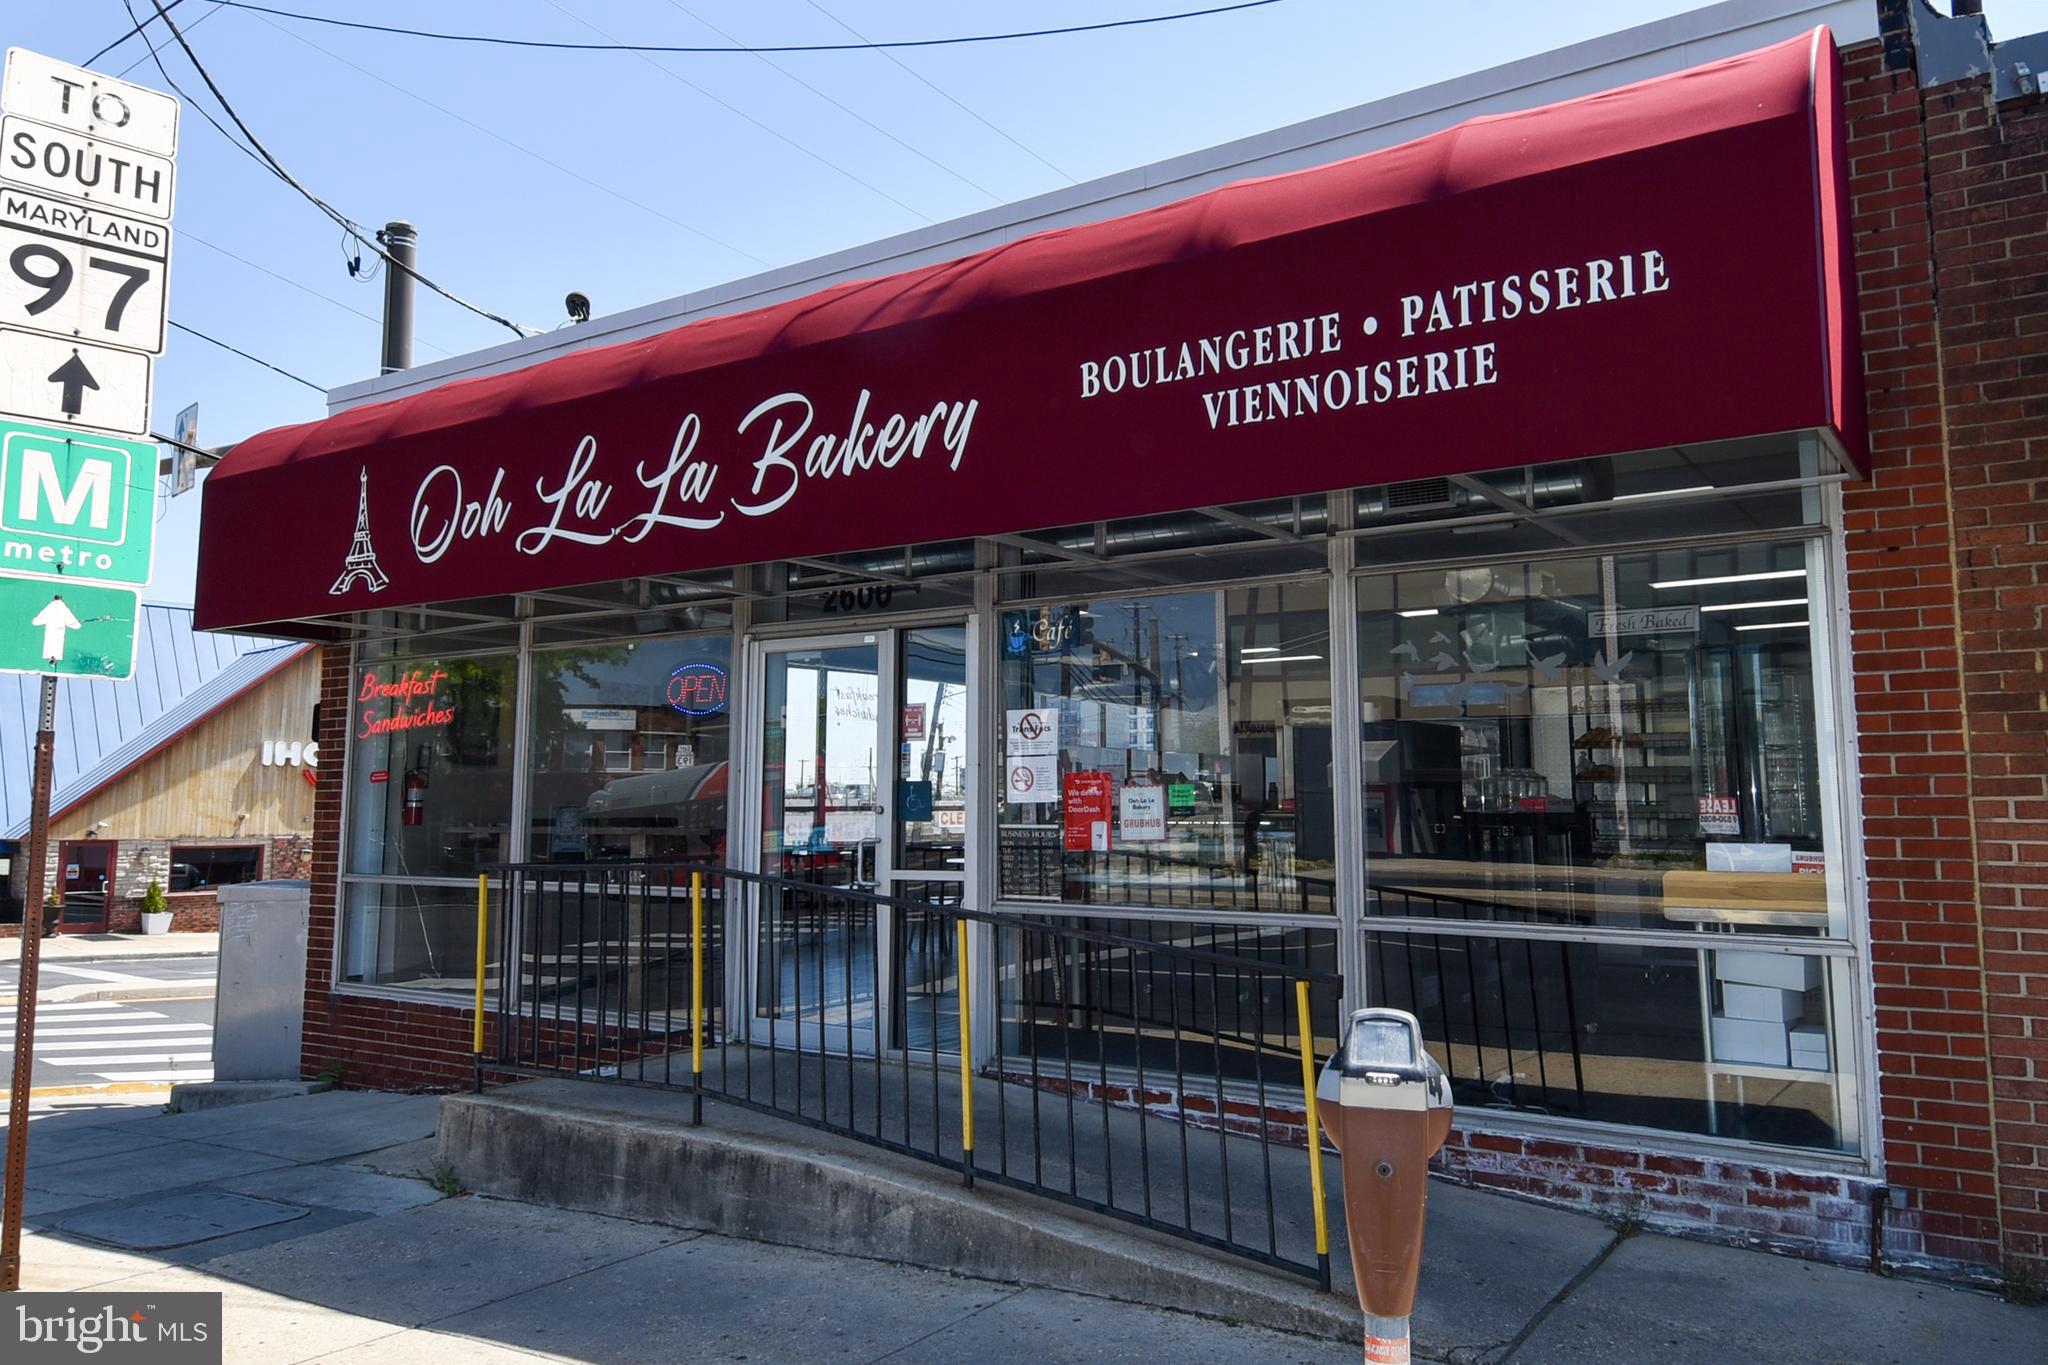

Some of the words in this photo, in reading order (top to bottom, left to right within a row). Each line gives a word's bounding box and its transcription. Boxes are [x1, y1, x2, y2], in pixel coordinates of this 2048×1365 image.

[51, 76, 130, 128] TO
[10, 132, 160, 204] SOUTH
[6, 197, 159, 249] MARYLAND
[9, 243, 150, 332] 97
[1401, 249, 1670, 337] PATISSERIE
[1202, 342, 1499, 429] VIENNOISERIE
[18, 449, 113, 530] M
[410, 464, 512, 564] Ooh
[515, 434, 615, 555] La
[621, 413, 725, 543] La
[731, 388, 979, 517] Bakery
[4, 541, 112, 570] metro
[1032, 615, 1073, 650] Café
[1595, 615, 1636, 632] Fresh
[1641, 611, 1691, 629] Baked
[358, 669, 448, 706] Breakfast
[666, 674, 726, 703] OPEN
[357, 701, 456, 739] Sandwiches
[1068, 789, 1080, 797] We
[1001, 830, 1030, 838] BUSINESS
[1031, 830, 1058, 839] HOURS
[1123, 818, 1161, 829] GRUBHUB
